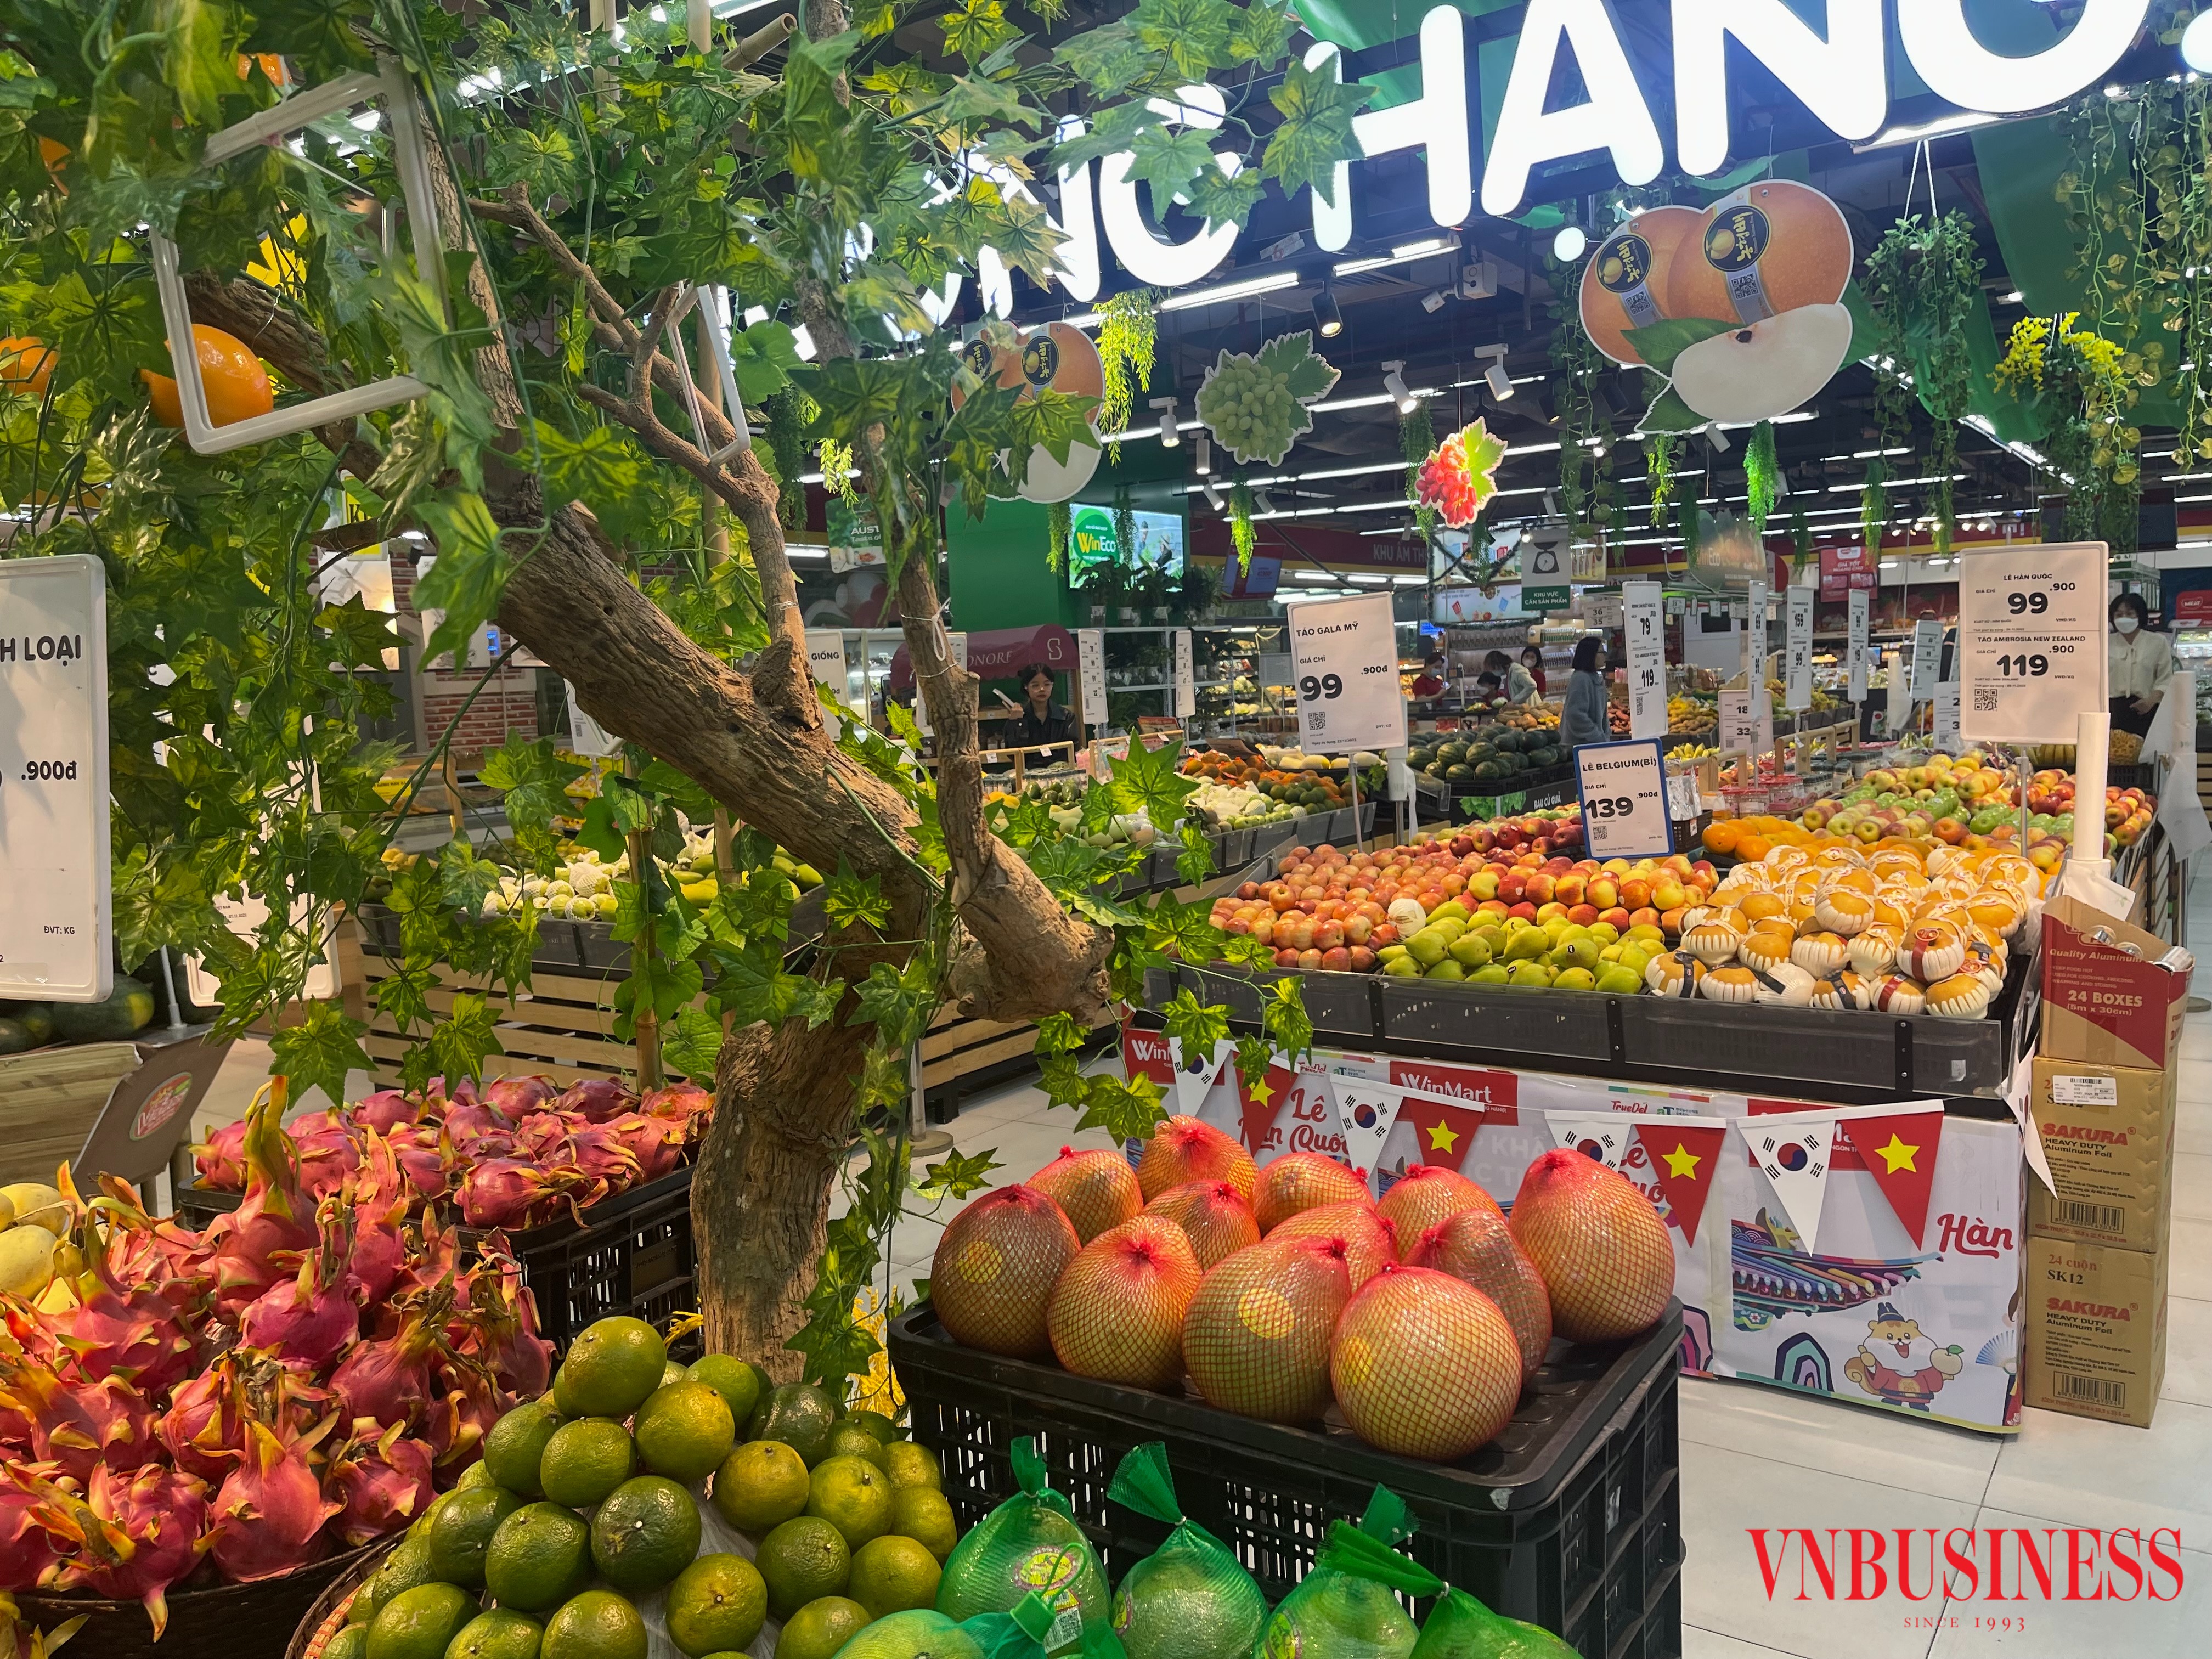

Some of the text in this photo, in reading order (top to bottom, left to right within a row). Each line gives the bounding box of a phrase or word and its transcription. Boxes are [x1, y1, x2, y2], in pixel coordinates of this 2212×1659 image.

[1373, 543, 1393, 561] KHU
[2007, 591, 2049, 614] 99
[1296, 620, 1358, 637] TÁO GALA MỸ
[1640, 617, 1651, 635] 79
[1794, 613, 1804, 627] 159
[24, 635, 81, 667] LOẠI
[811, 650, 840, 661] GIỐNG
[1300, 654, 1325, 664] GIÁ CHỈ
[1361, 664, 1387, 675] .900đ
[1996, 654, 2049, 676] 119
[1641, 669, 1654, 688] 119
[1300, 673, 1343, 702] 99
[1737, 727, 1751, 736] 33
[21, 760, 77, 780] .900đ
[1582, 762, 1594, 771] LÊ
[1533, 798, 1544, 810] RAU
[1585, 797, 1634, 819] 139
[44, 926, 63, 934] ĐVT:
[2050, 948, 2143, 963] Quality Aluminum
[2068, 990, 2143, 1007] 24 BOXES
[2067, 1003, 2086, 1012] (5m
[2099, 1006, 2132, 1016] 30cm)
[1400, 1072, 1492, 1103] WinMart
[1290, 1088, 1327, 1122] Lê
[2041, 1122, 2128, 1146] SAKURA
[2045, 1137, 2107, 1150] HEAVY DUTY
[2045, 1144, 2092, 1155] Aluminum
[1937, 1213, 2014, 1259] Hàn
[2048, 1254, 2097, 1272] 24 cuộn
[2047, 1269, 2084, 1285] SK12
[2046, 1297, 2131, 1322] SAKURA
[2046, 1312, 2107, 1328] HEAVY DUTY
[2046, 1319, 2113, 1335] Aluminum Foil
